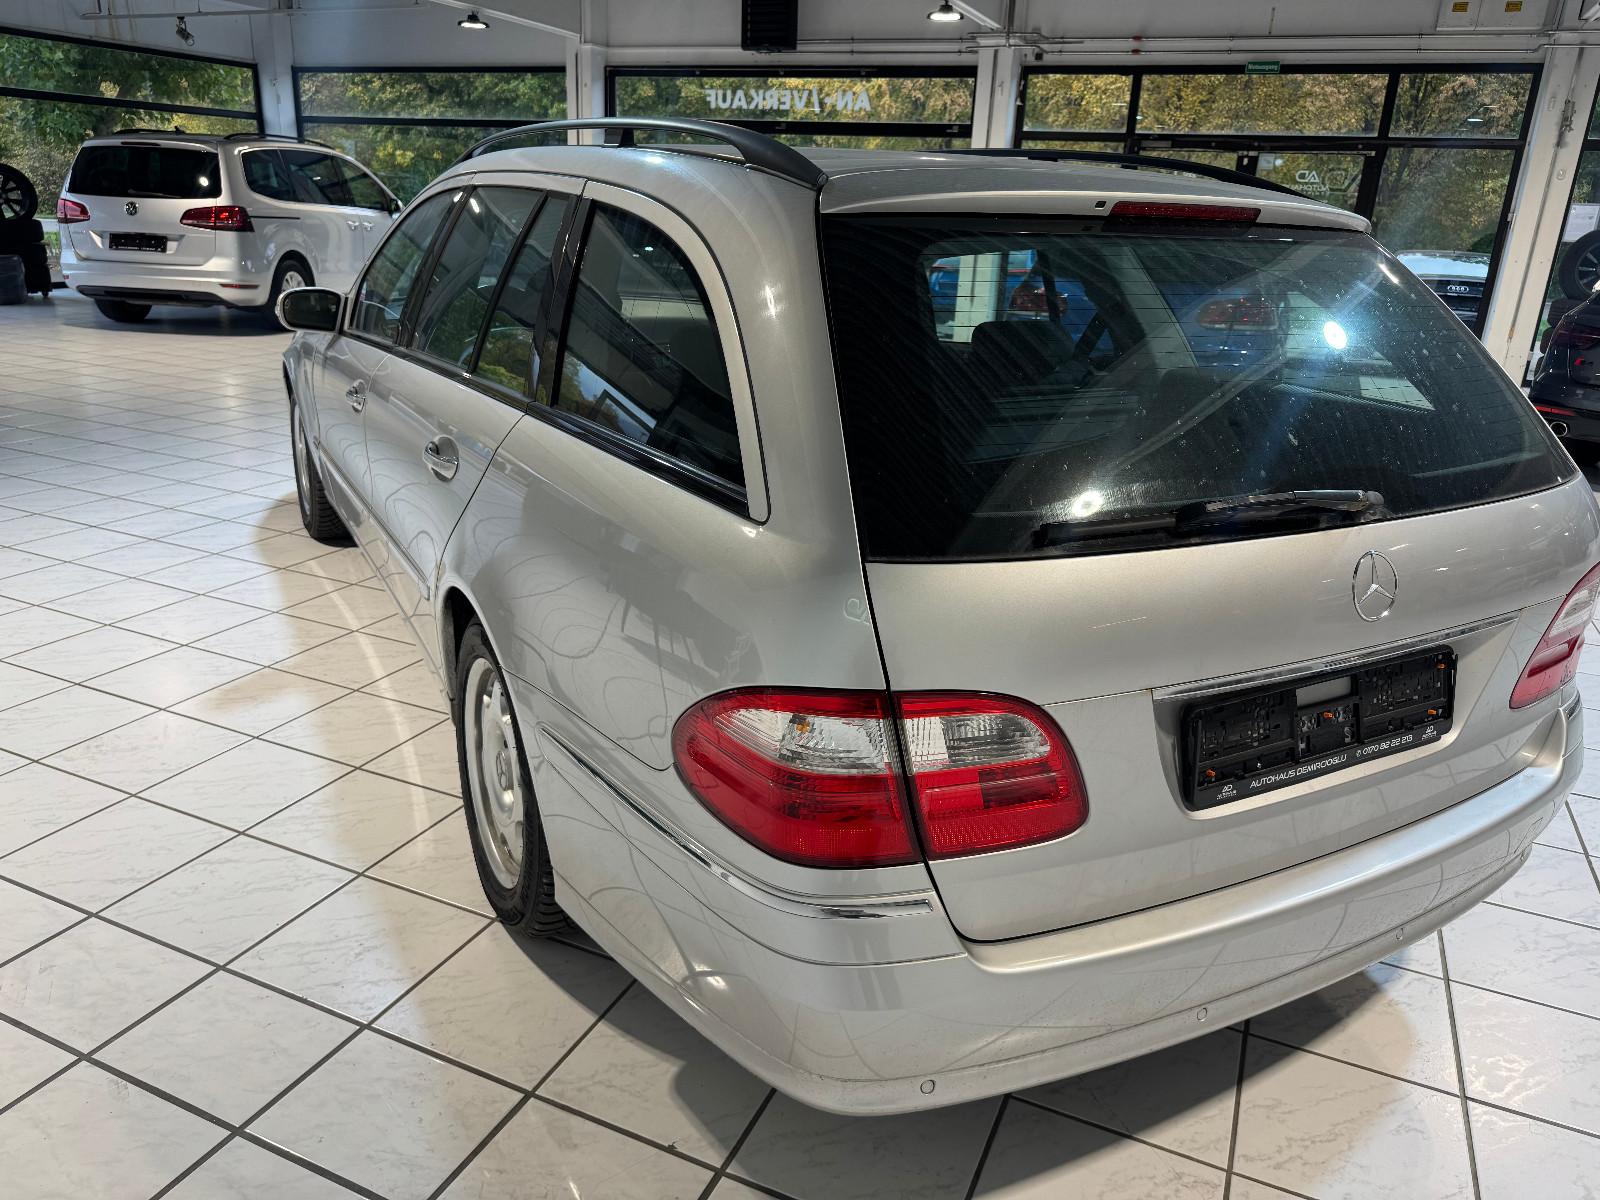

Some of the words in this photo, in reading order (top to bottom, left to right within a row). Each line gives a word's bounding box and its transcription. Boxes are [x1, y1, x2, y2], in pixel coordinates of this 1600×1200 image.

[1249, 769, 1296, 789] AUTOHAUS
[1362, 744, 1379, 755] 0170
[1379, 741, 1391, 750] 82
[1391, 737, 1401, 747] 22
[1401, 734, 1413, 744] 213
